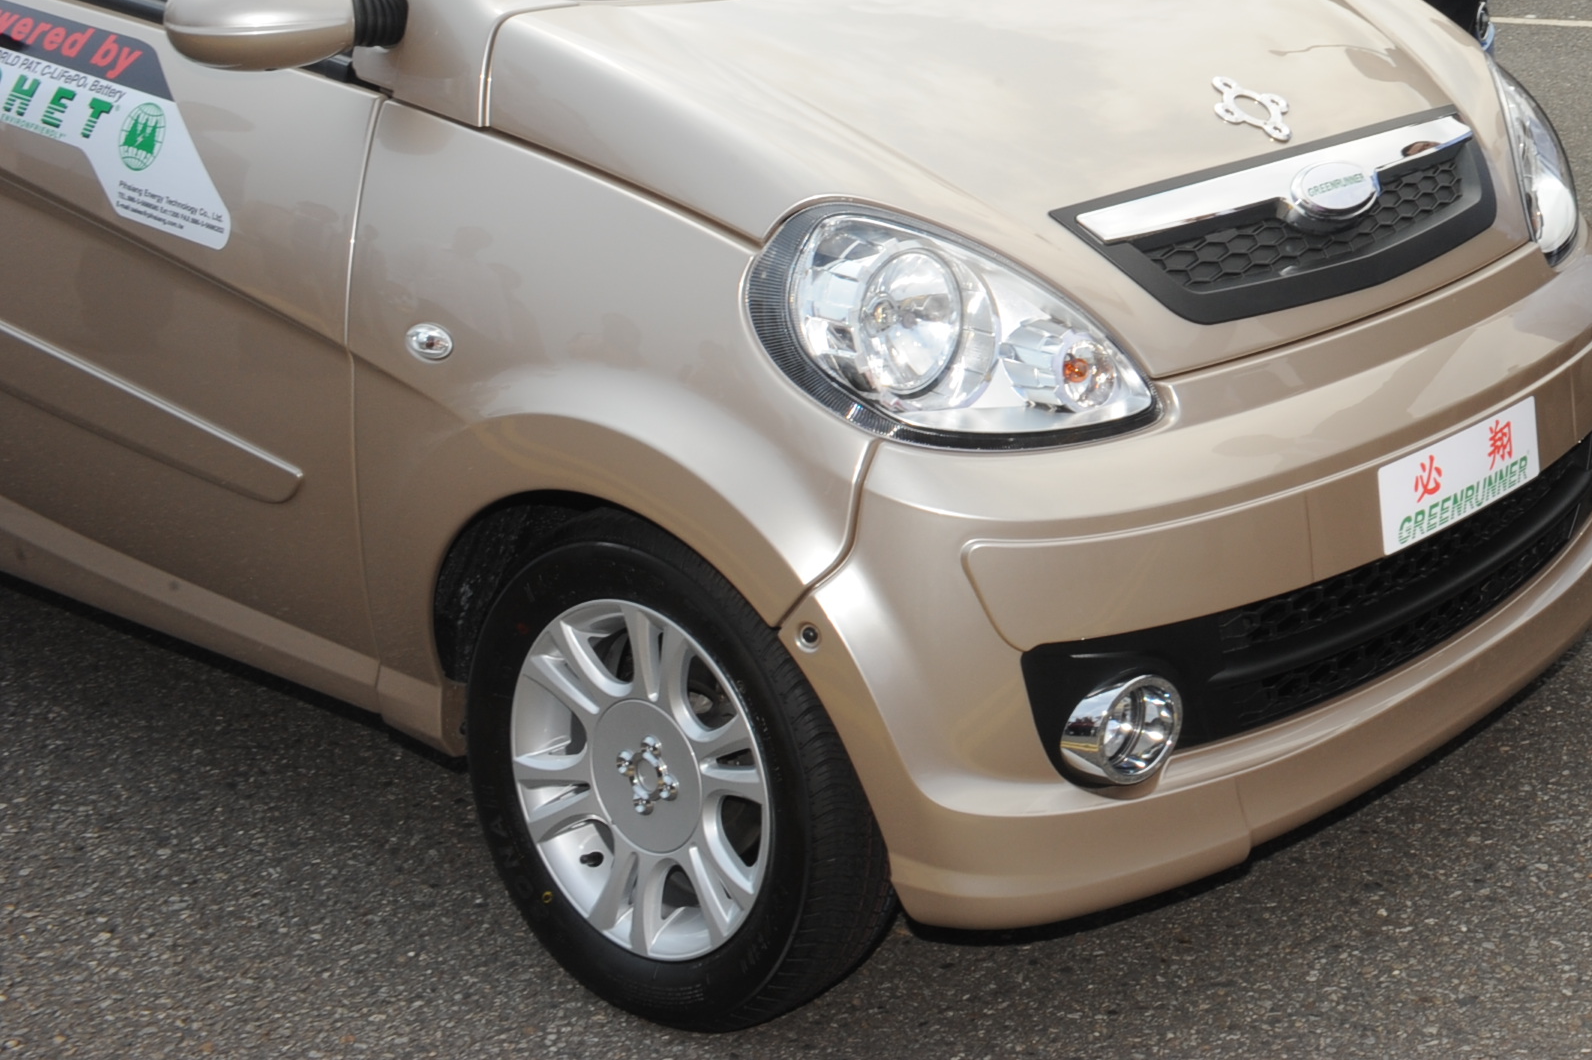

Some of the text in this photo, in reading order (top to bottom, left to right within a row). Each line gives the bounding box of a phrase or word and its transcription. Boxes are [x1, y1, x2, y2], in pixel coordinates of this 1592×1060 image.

[89, 34, 143, 79] by
[88, 80, 127, 103] Battery
[144, 189, 164, 204] Energy
[165, 196, 198, 216] Technology
[1308, 173, 1364, 197] GREENRUNNER
[1414, 420, 1513, 503] 必翔
[1398, 455, 1528, 545] GREENRUNNER
